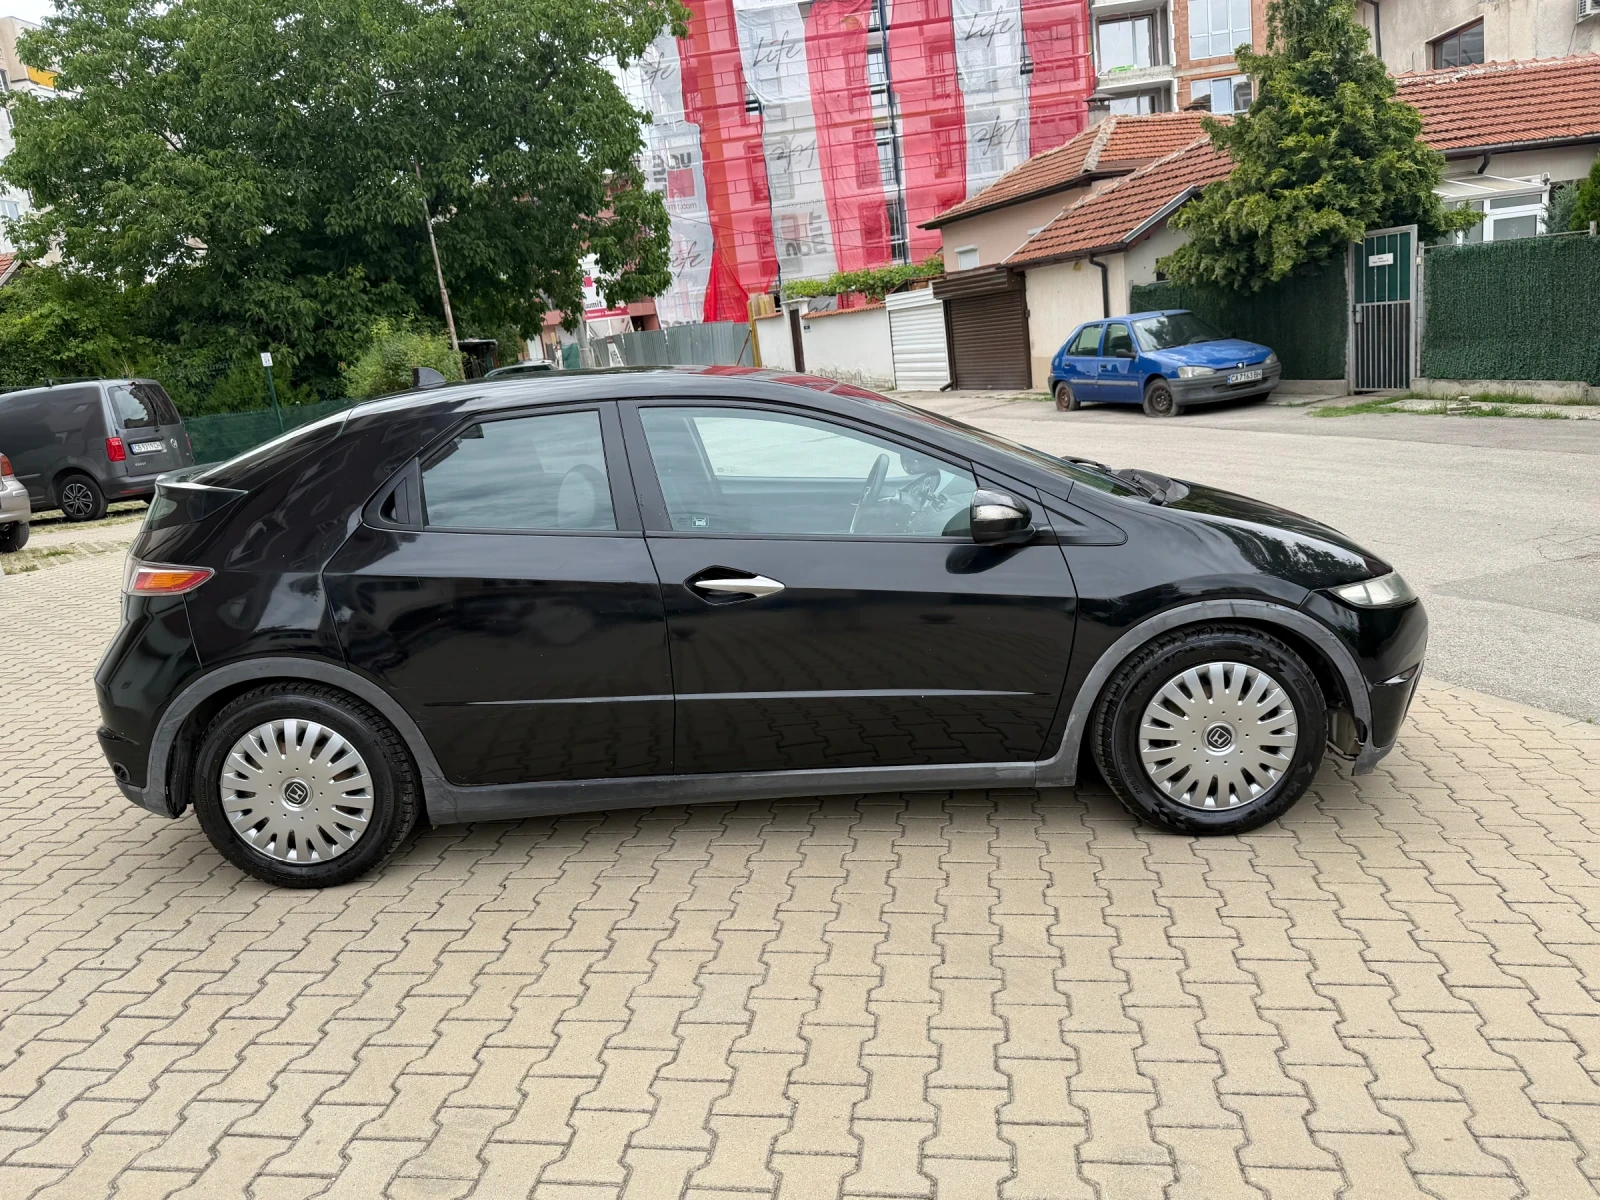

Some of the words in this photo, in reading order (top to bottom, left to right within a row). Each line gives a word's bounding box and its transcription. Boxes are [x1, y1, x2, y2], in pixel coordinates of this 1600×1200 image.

[965, 5, 1016, 47] Life
[753, 30, 801, 72] Life
[643, 52, 676, 91] ife
[671, 240, 706, 278] ife
